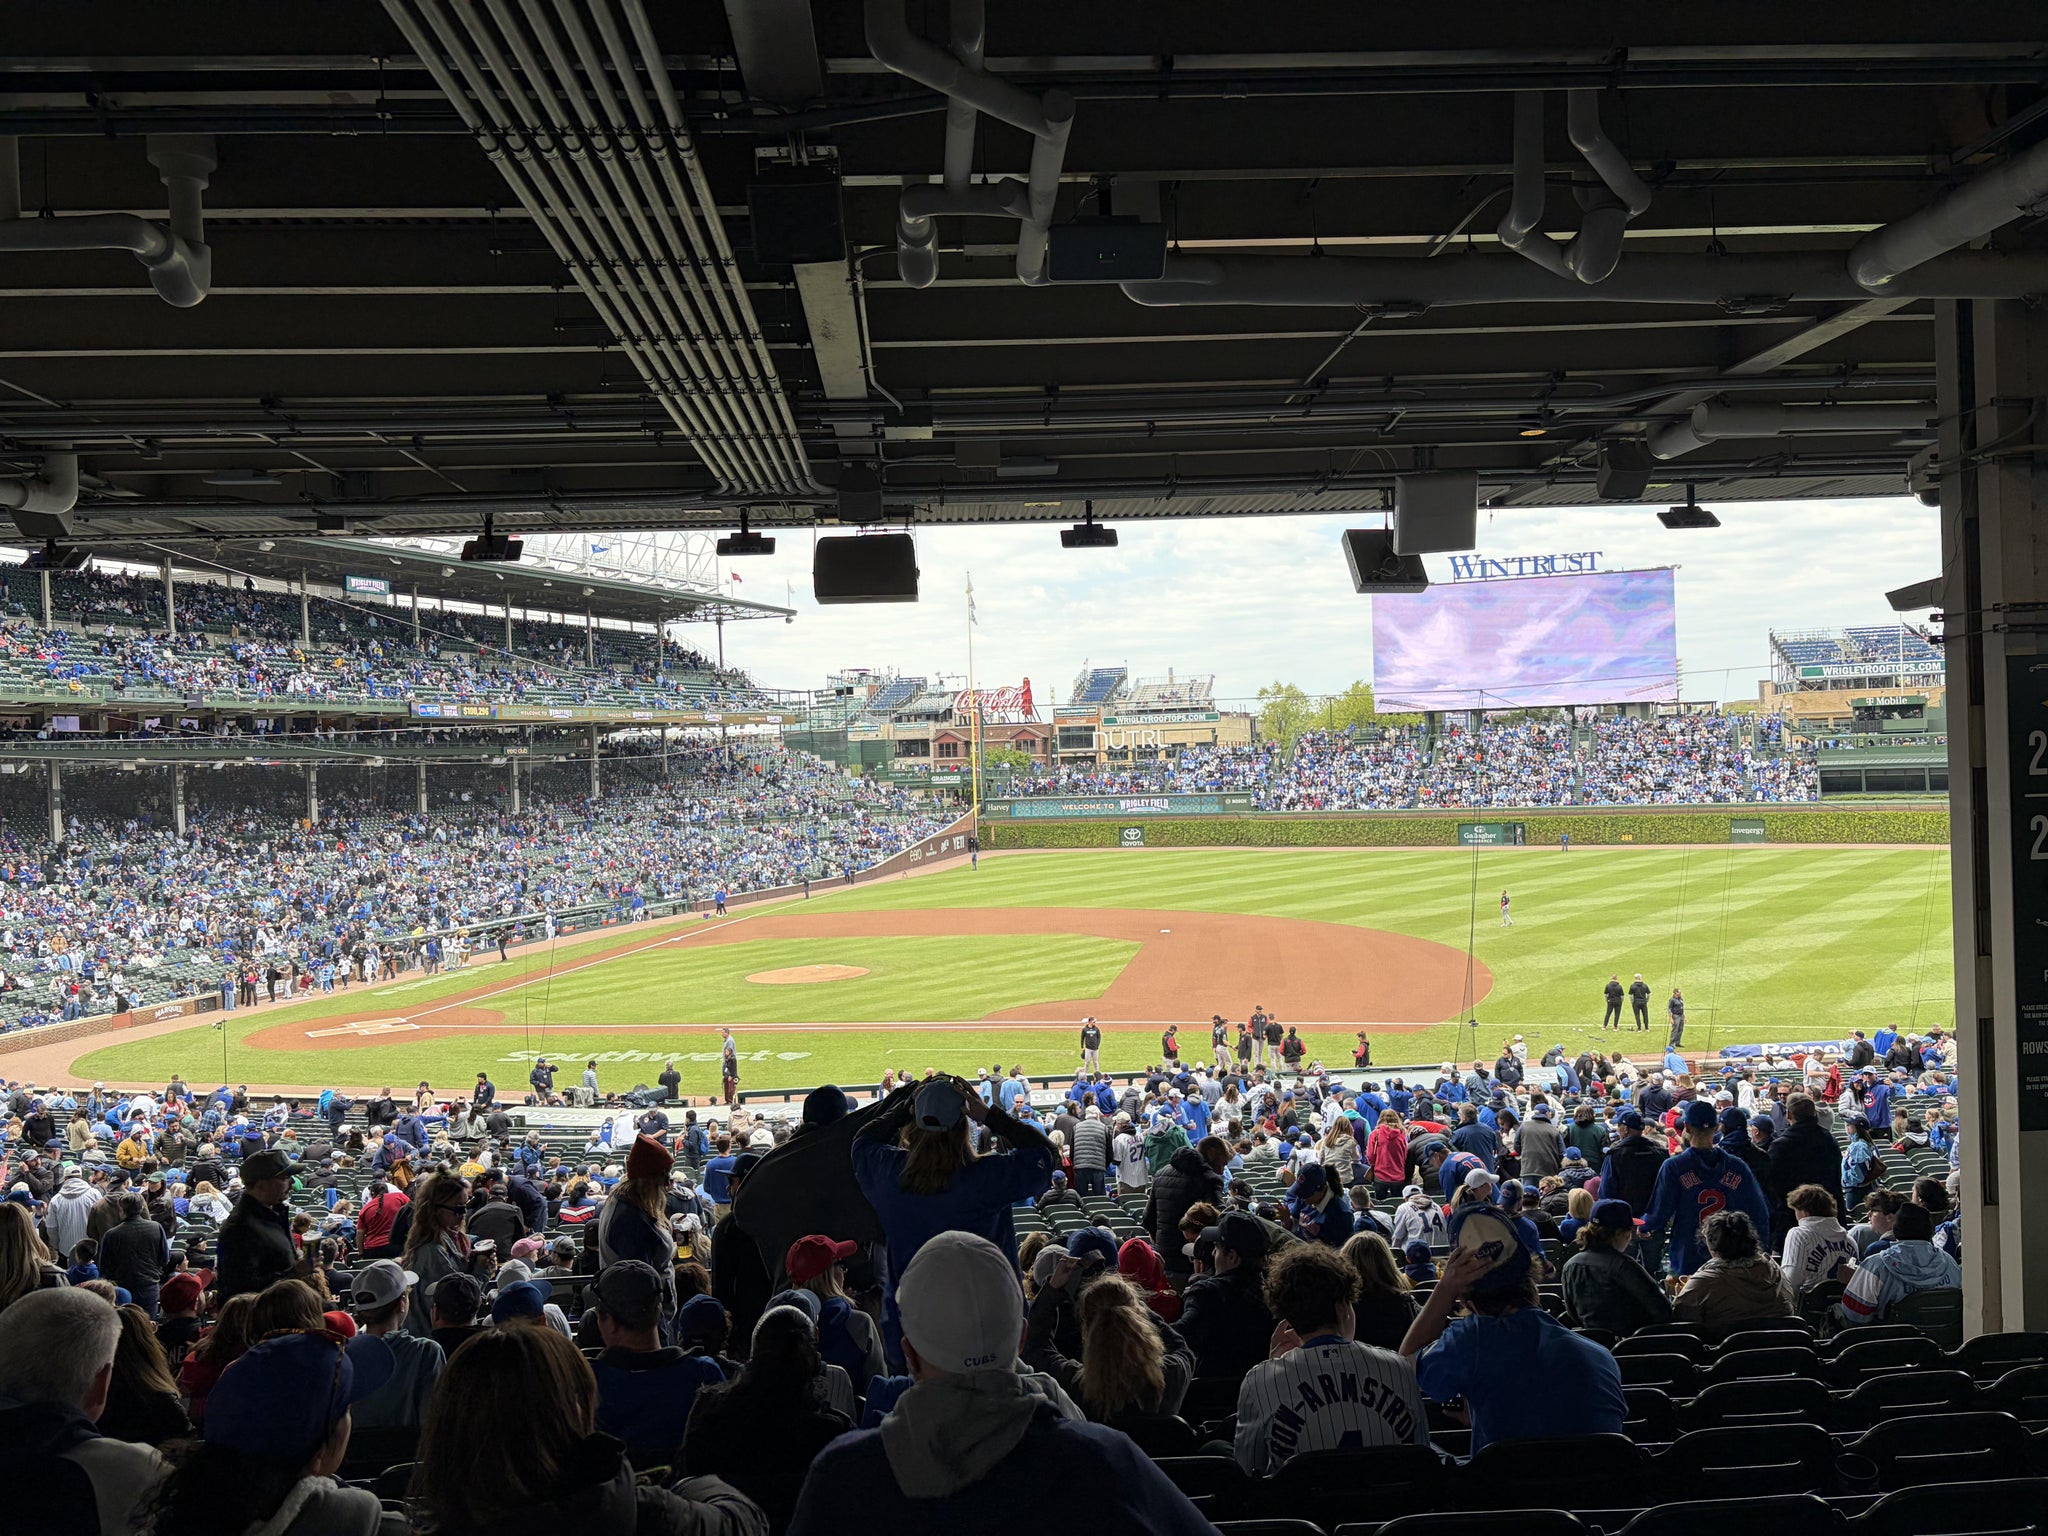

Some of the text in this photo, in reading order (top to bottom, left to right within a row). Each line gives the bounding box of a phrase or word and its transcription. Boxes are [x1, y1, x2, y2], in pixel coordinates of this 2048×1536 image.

[1448, 551, 1603, 579] WINTRUST
[1822, 662, 1942, 677] WRIGLEYROOFTOPS.COM
[1876, 696, 1908, 706] Mobile
[1115, 713, 1206, 724] WRIGLEYROOFTOPS.COM
[988, 803, 1010, 812] Harvey
[1120, 799, 1149, 810] WRIGLEY
[1150, 798, 1169, 809] FIELD
[1731, 826, 1765, 836] Invenergy
[952, 835, 965, 850] YETI
[1129, 1144, 1144, 1163] 27
[964, 1353, 997, 1368] CUBS
